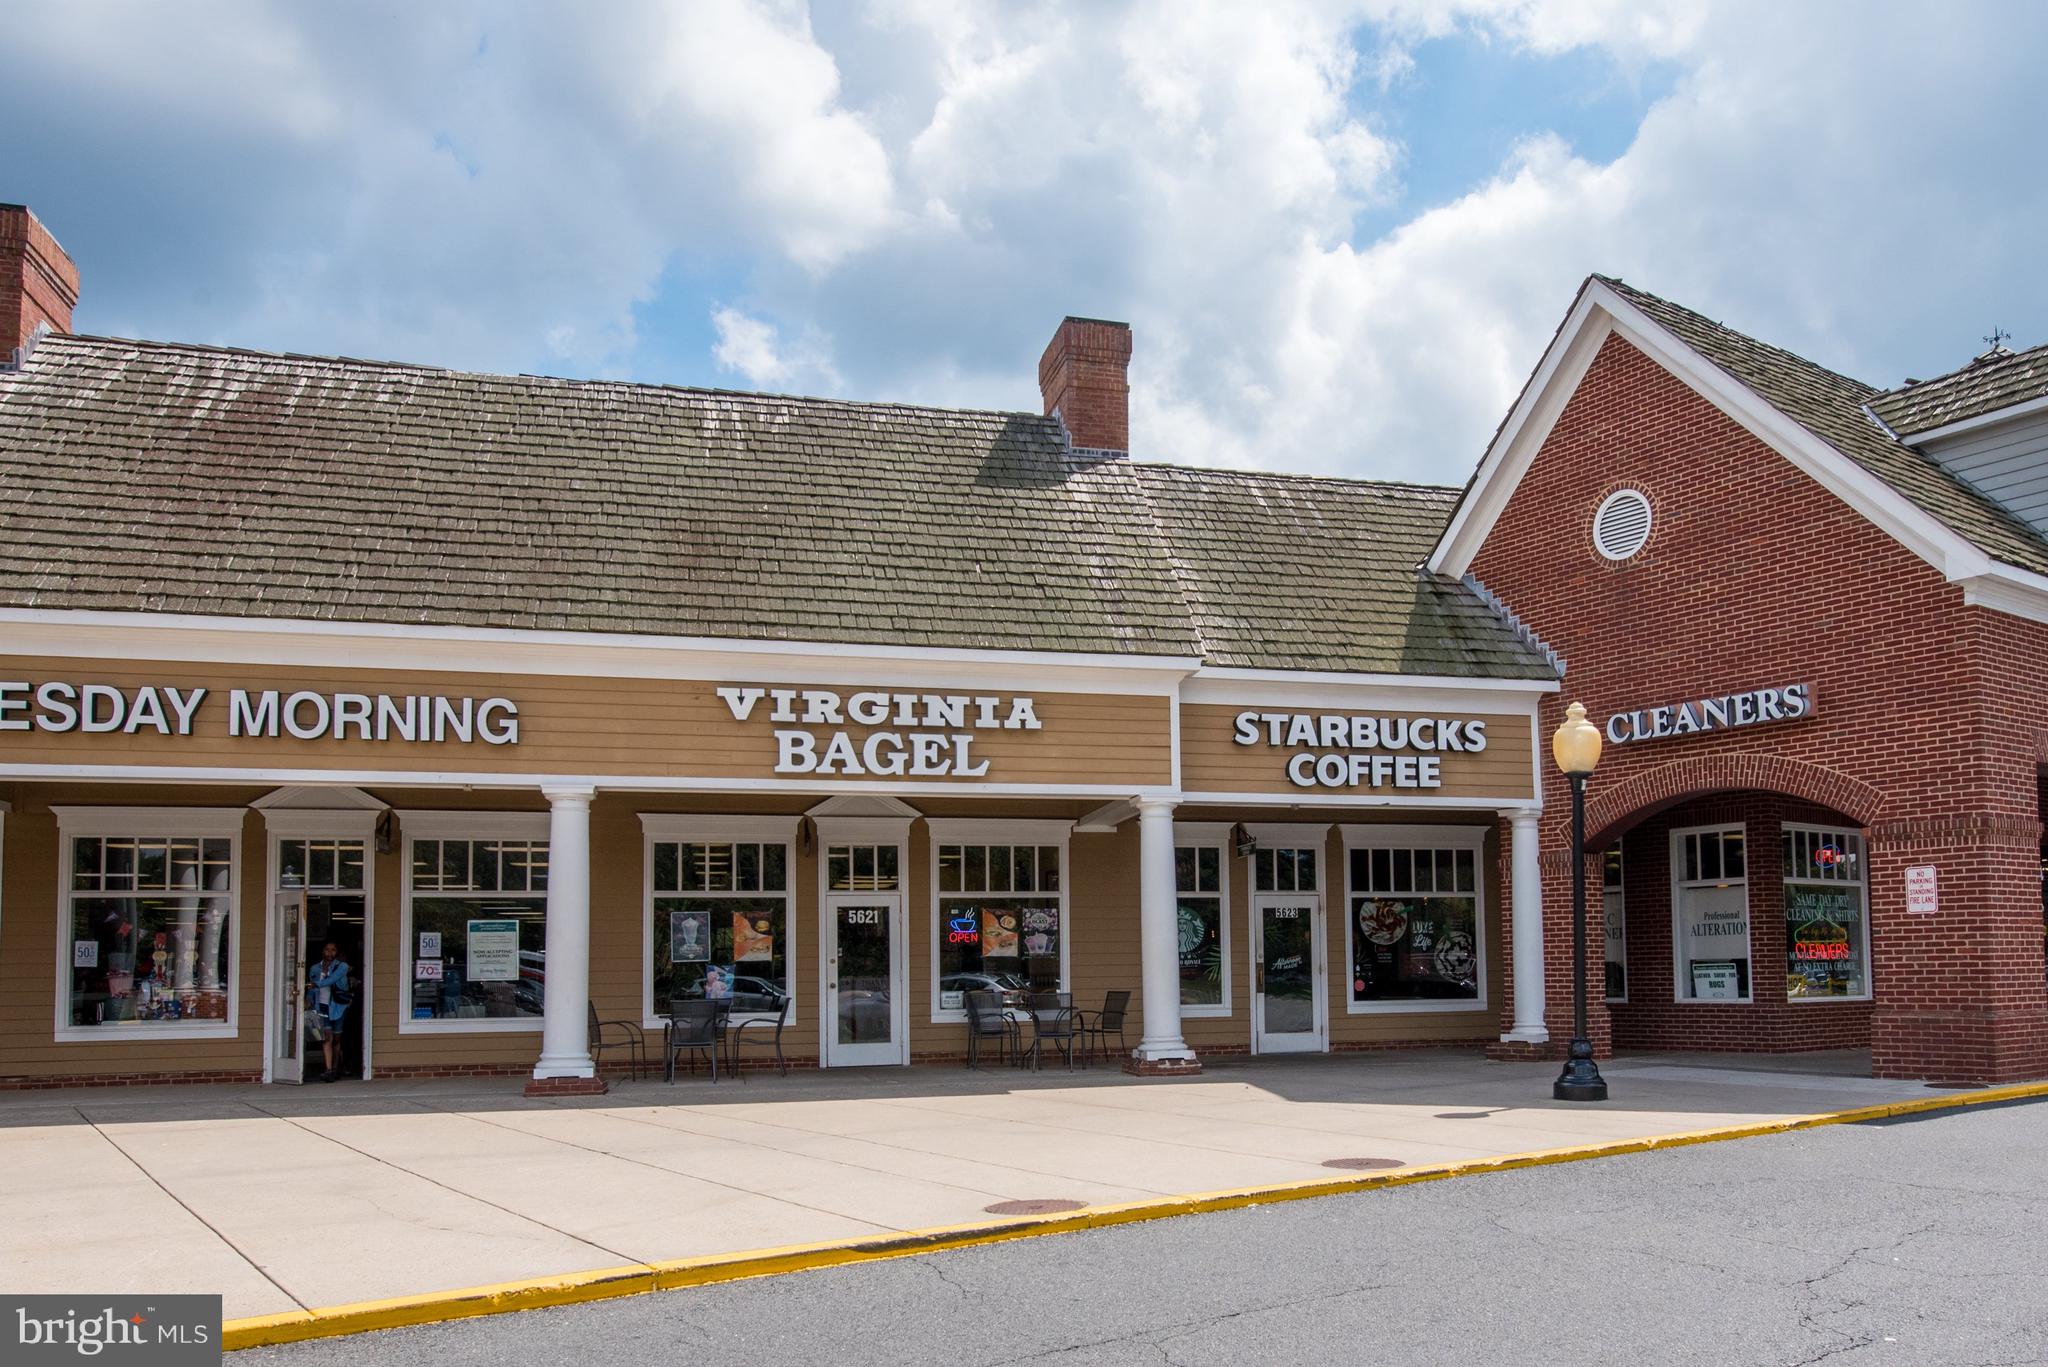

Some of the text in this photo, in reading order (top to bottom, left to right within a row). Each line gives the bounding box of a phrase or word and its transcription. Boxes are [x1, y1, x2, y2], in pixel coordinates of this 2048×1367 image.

[229, 689, 520, 744] MORNING
[716, 687, 1042, 729] VIRGINIA
[1606, 684, 1808, 744] CLEANERS
[1233, 711, 1487, 753] STARBUCKS
[774, 730, 991, 777] BAGEL
[1286, 753, 1442, 788] COFFEE
[848, 910, 878, 924] 5621
[1276, 908, 1298, 918] 5623
[1704, 910, 1740, 920] Professional
[1796, 894, 1849, 907] SAME DAY DRY
[949, 932, 978, 943] OPEN
